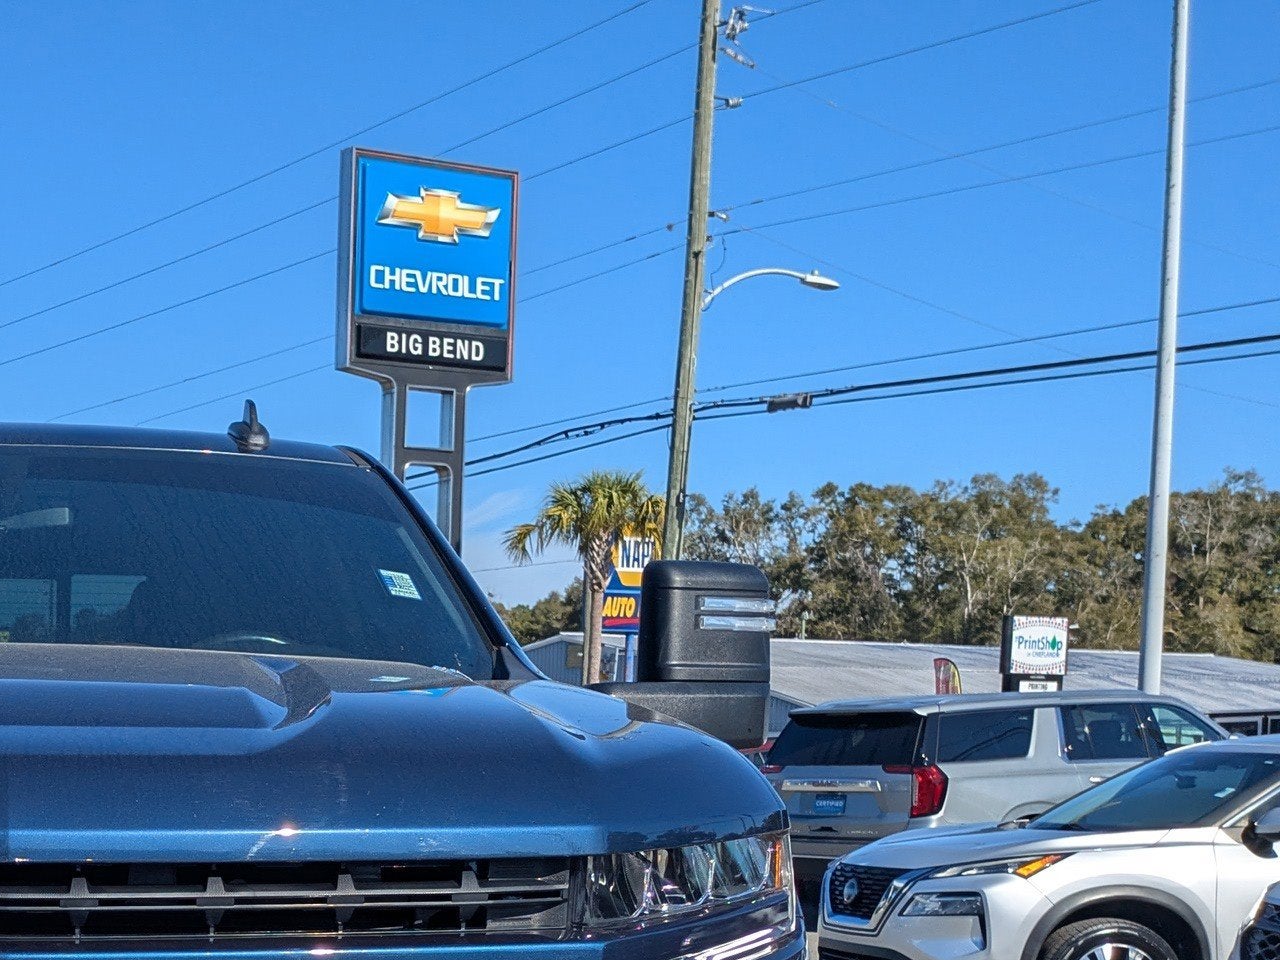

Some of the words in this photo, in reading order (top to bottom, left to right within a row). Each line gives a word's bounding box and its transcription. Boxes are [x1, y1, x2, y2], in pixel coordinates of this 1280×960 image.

[370, 265, 505, 301] CHEVROLET
[386, 331, 423, 355] BIG
[428, 337, 485, 361] BEND
[621, 540, 654, 568] NAP
[602, 597, 635, 617] AUTO
